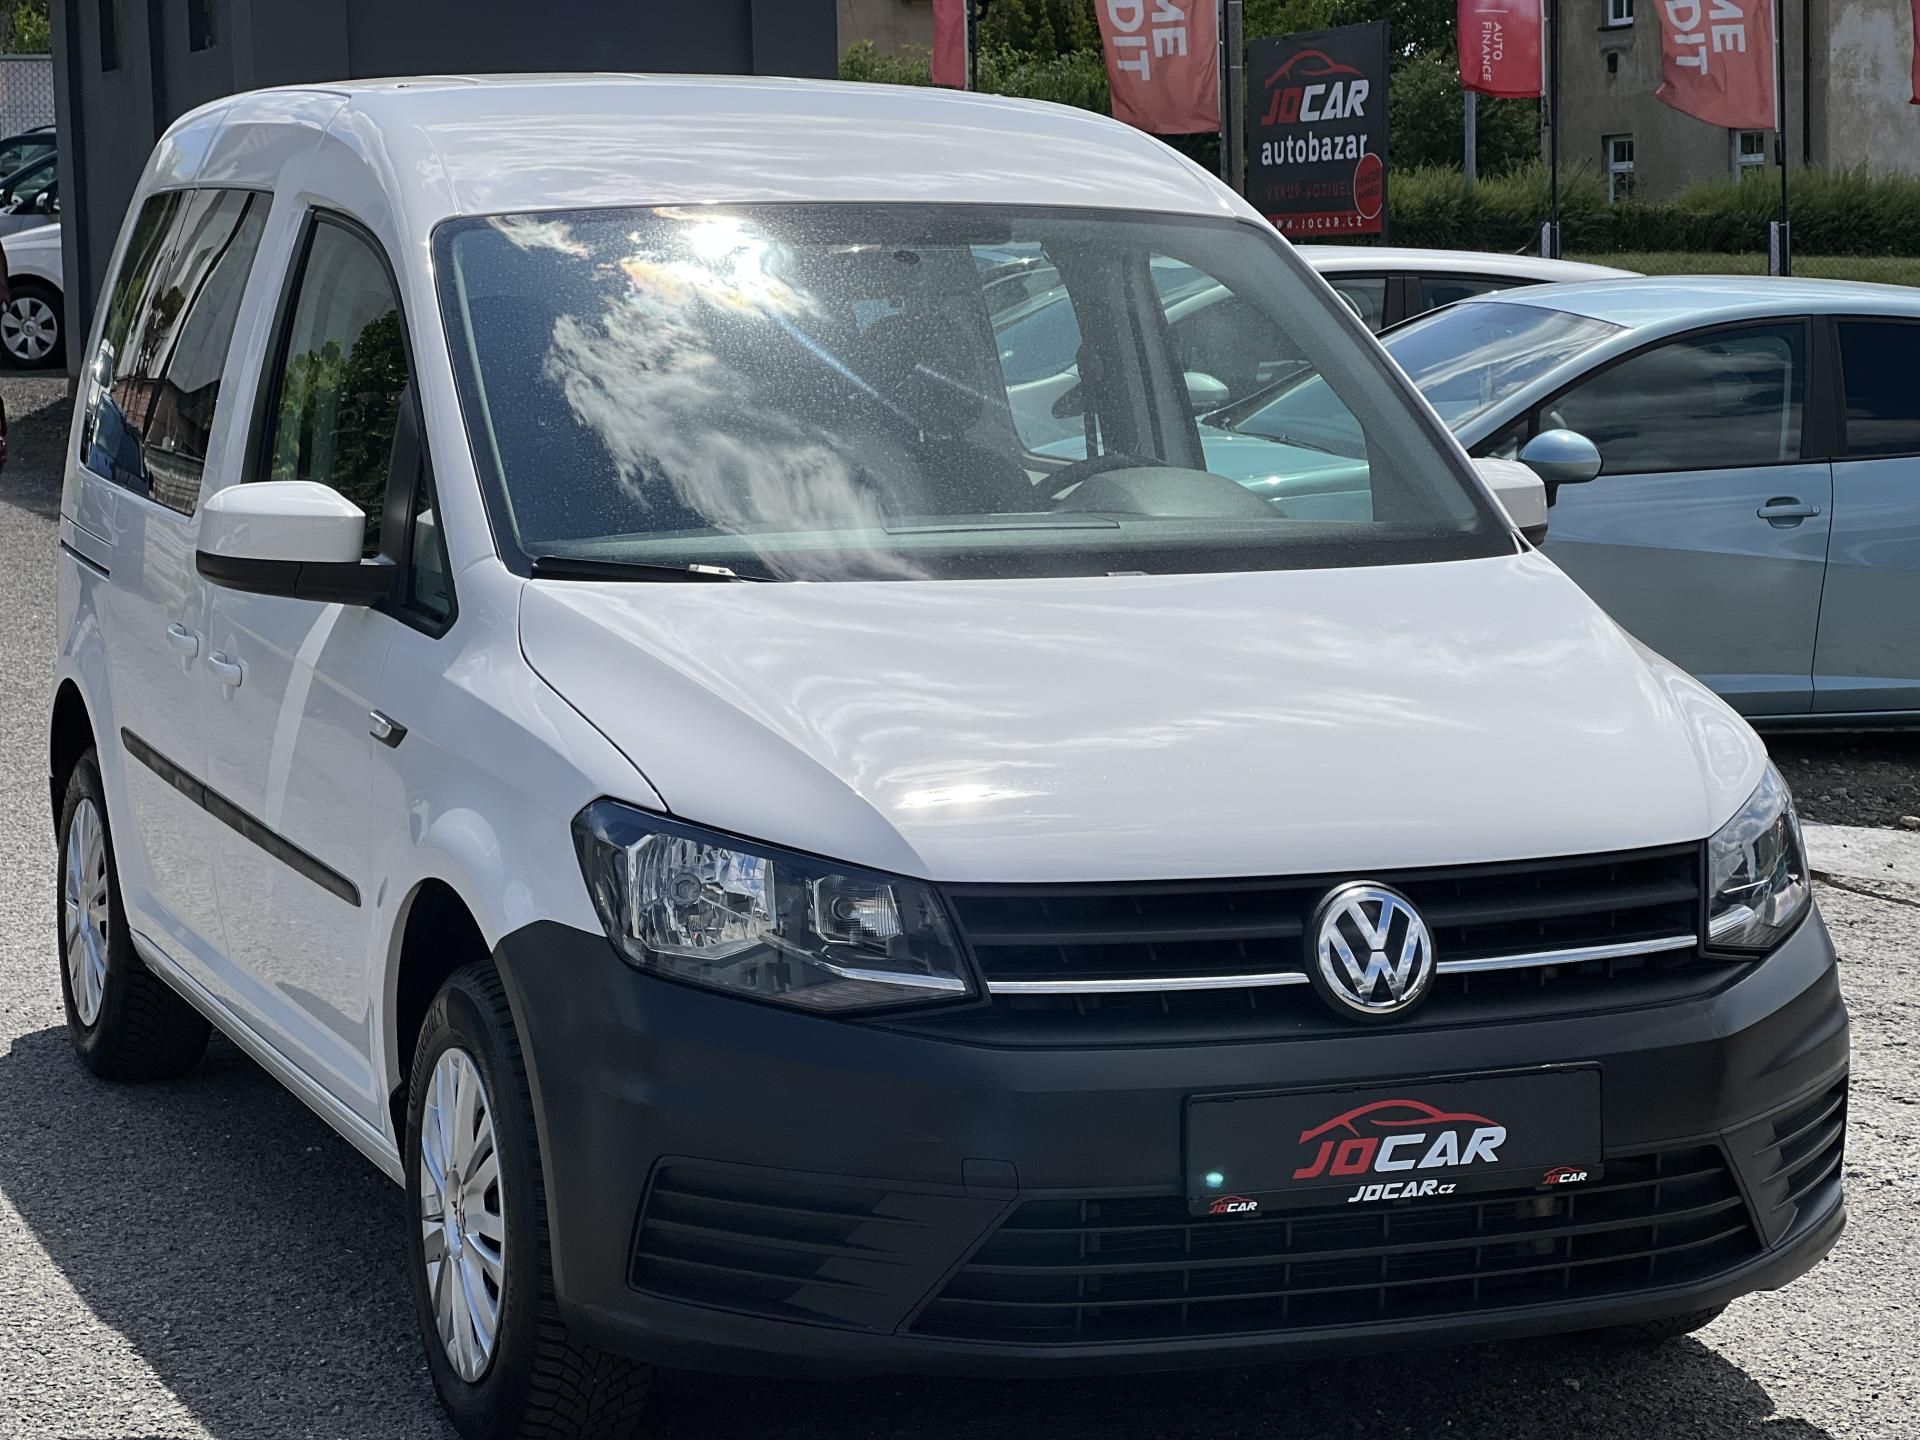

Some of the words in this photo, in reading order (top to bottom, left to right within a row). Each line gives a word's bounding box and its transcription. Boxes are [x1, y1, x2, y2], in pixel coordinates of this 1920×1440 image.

[1482, 22, 1492, 82] FINANCE
[1493, 22, 1503, 61] AUTO
[1261, 79, 1370, 126] JOCAR
[1261, 130, 1368, 166] autobazar
[1293, 1126, 1507, 1180] JOCAR
[1541, 1171, 1588, 1185] JOCAR
[1208, 1201, 1258, 1214] JOCAR
